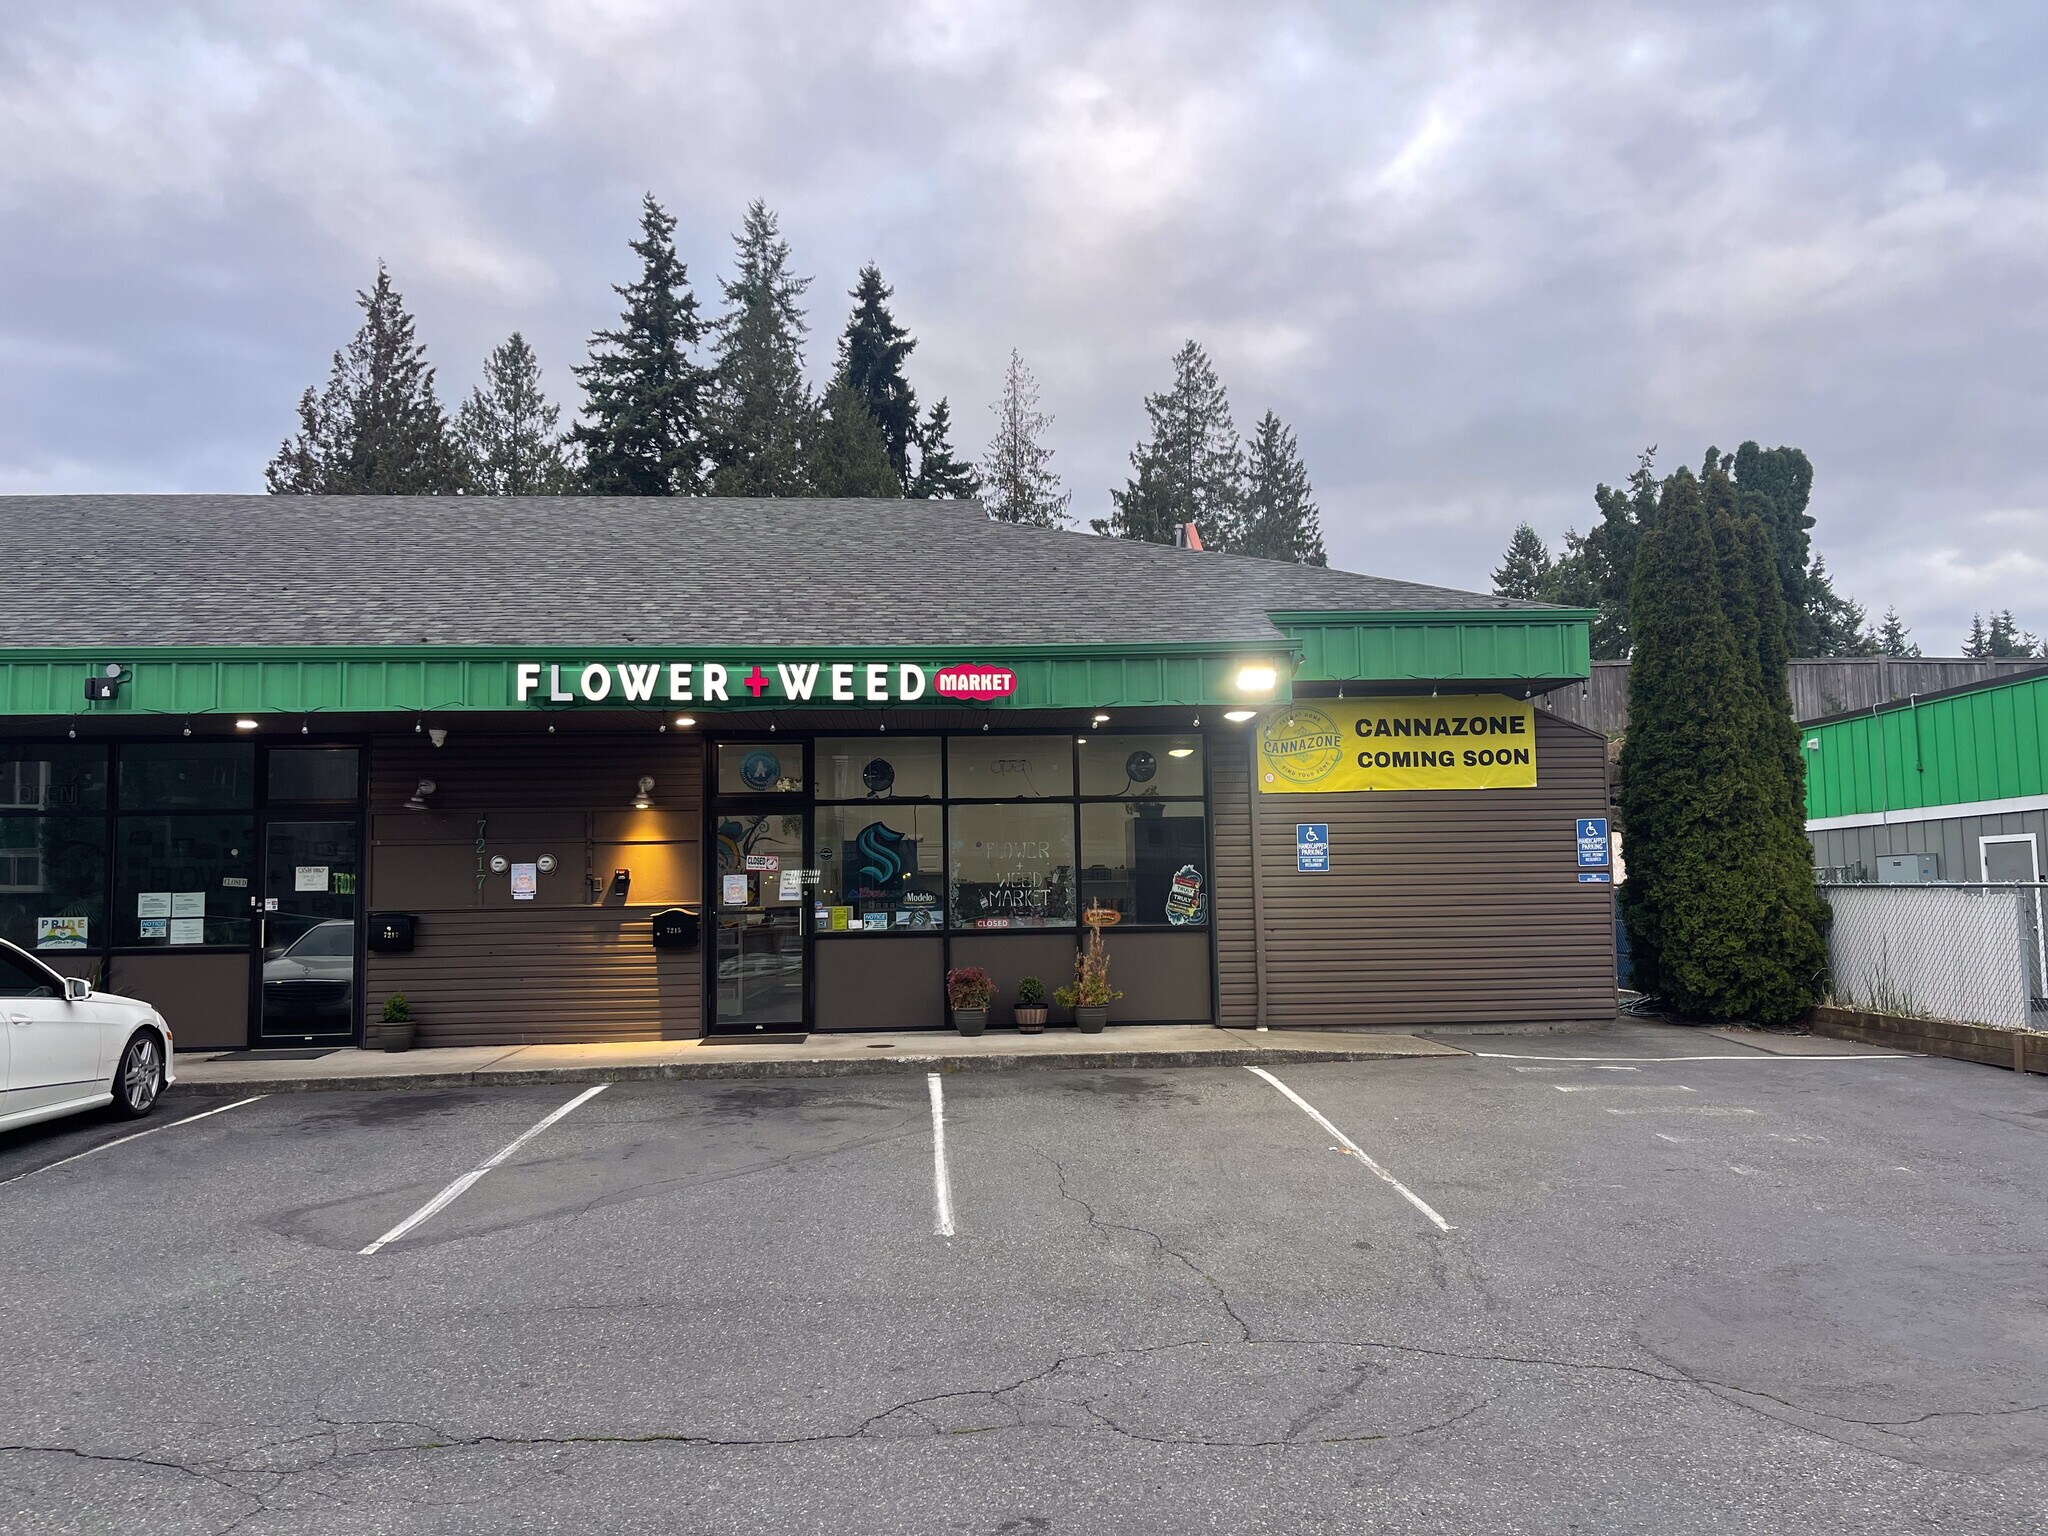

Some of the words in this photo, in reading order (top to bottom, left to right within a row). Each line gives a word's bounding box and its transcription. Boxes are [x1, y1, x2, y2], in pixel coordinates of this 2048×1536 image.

[517, 663, 729, 701] FLOWER
[777, 663, 926, 701] WEED
[939, 674, 1012, 691] MARKET
[1355, 716, 1526, 737] CANNAZONE
[1264, 736, 1341, 753] CANNAZONE
[1357, 750, 1455, 768] COMING
[1463, 748, 1529, 767] SOON
[476, 820, 486, 889] 7217
[986, 841, 1050, 859] FLOWER
[748, 857, 766, 866] CLOSED
[224, 878, 247, 887] CLOSED
[996, 872, 1043, 888] WEED
[860, 887, 886, 898] Coors
[907, 893, 933, 902] Modelo
[1177, 886, 1193, 894] TRULY
[989, 889, 1051, 908] MARKET
[1174, 894, 1192, 903] TRULY
[42, 919, 85, 929] PRIDE
[977, 919, 1008, 927] CLOSED
